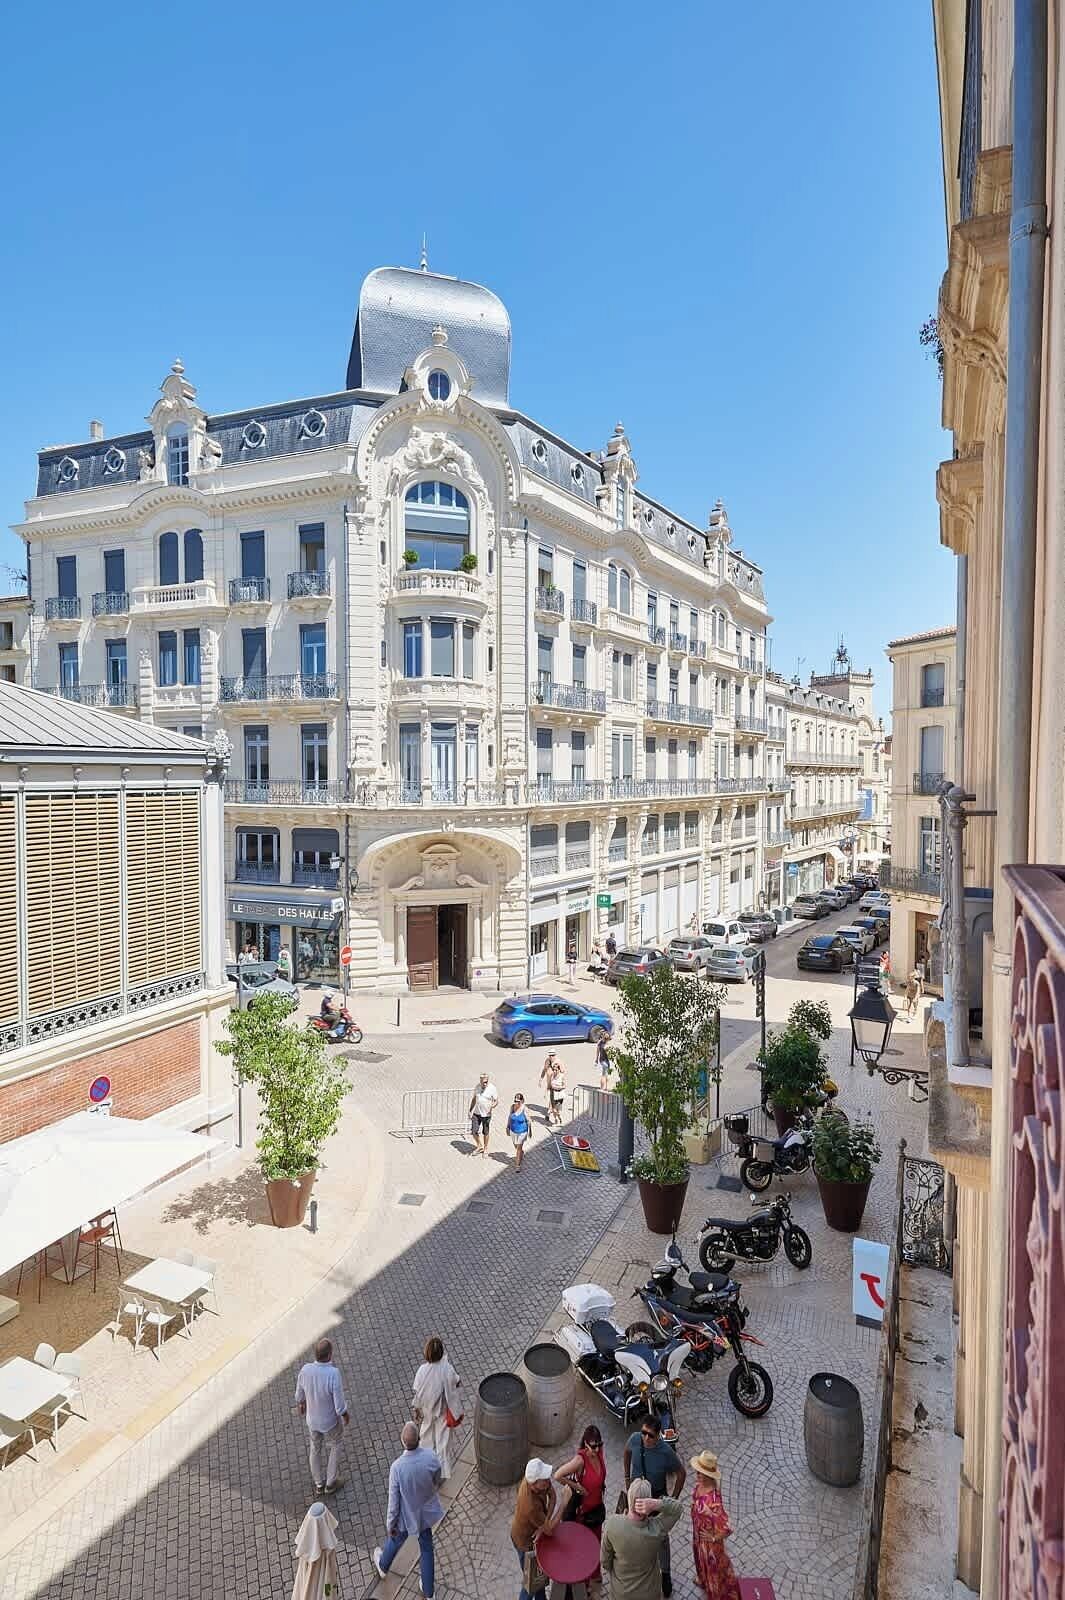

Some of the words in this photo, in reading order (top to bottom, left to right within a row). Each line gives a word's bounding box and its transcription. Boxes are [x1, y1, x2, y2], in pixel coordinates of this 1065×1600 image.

[232, 904, 243, 913] LE
[278, 907, 297, 918] DES
[299, 909, 335, 921] HALLES
